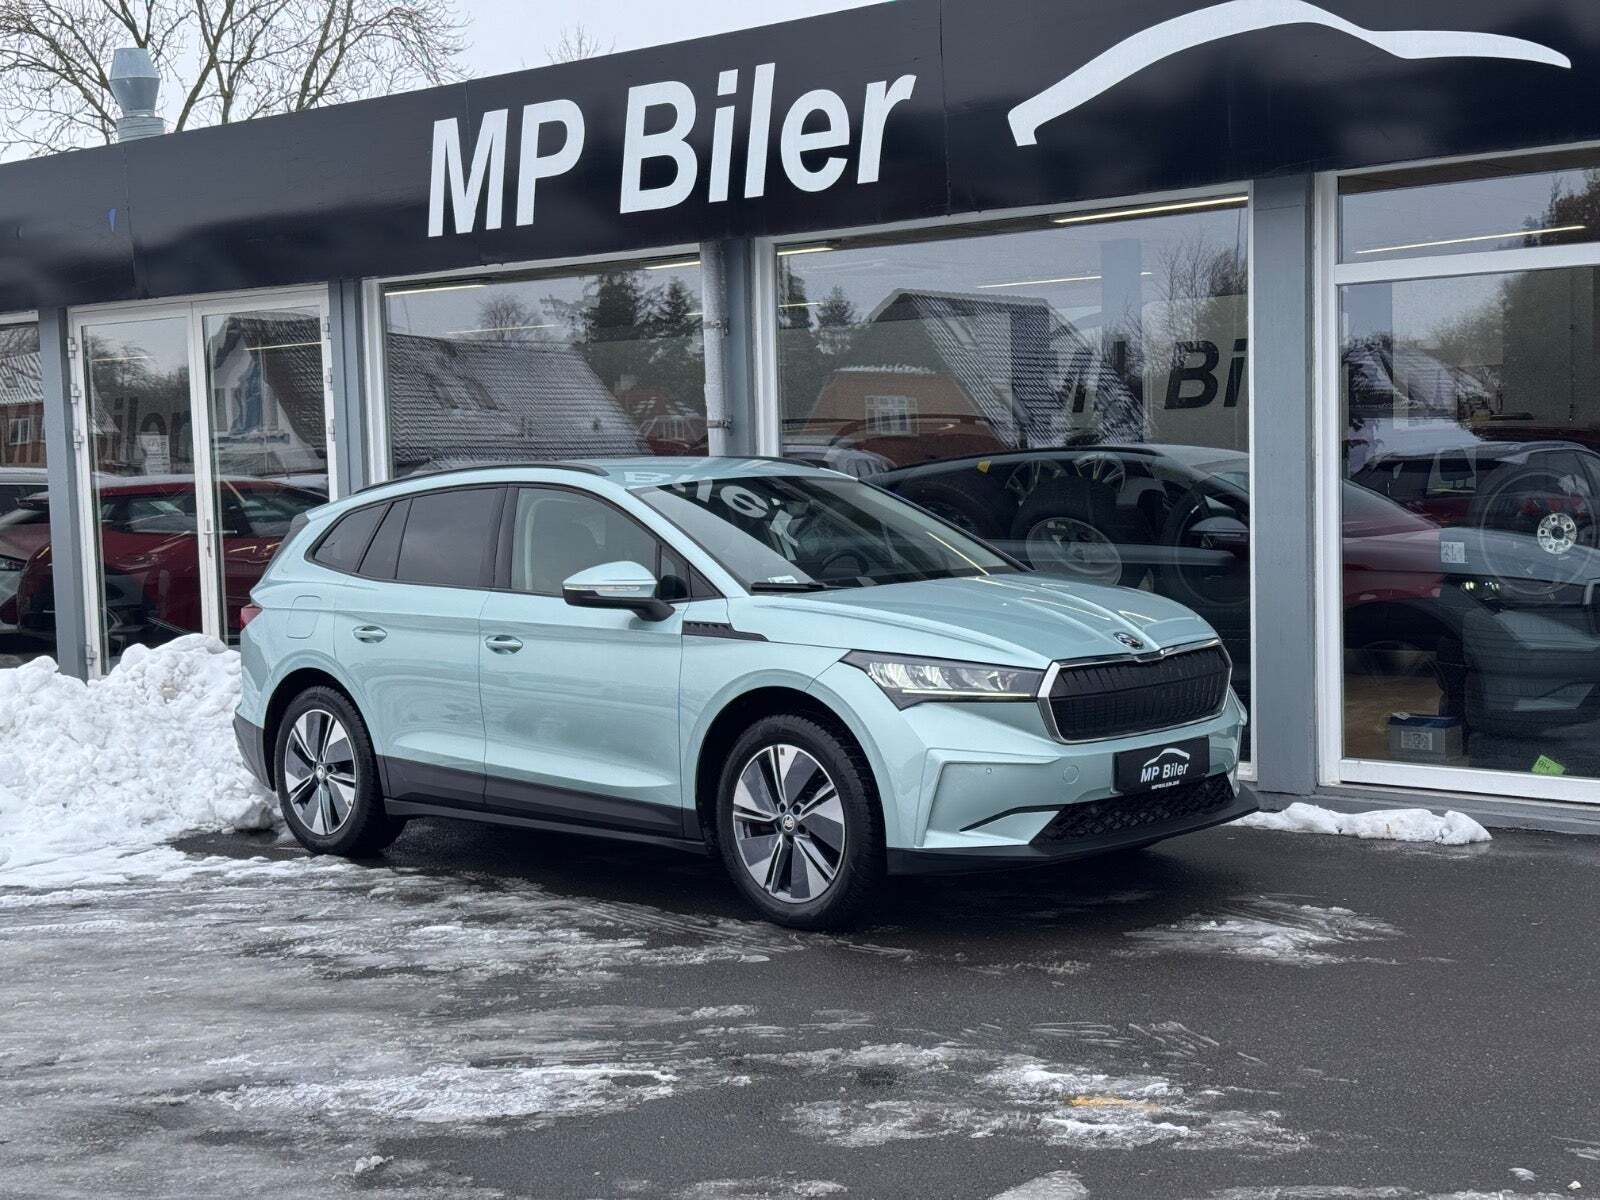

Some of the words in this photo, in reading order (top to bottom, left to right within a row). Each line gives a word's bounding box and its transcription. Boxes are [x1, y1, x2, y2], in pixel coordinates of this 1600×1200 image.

[427, 98, 585, 238] MP
[619, 62, 917, 215] Biler
[1140, 766, 1160, 783] MP
[1162, 762, 1189, 778] Biler
